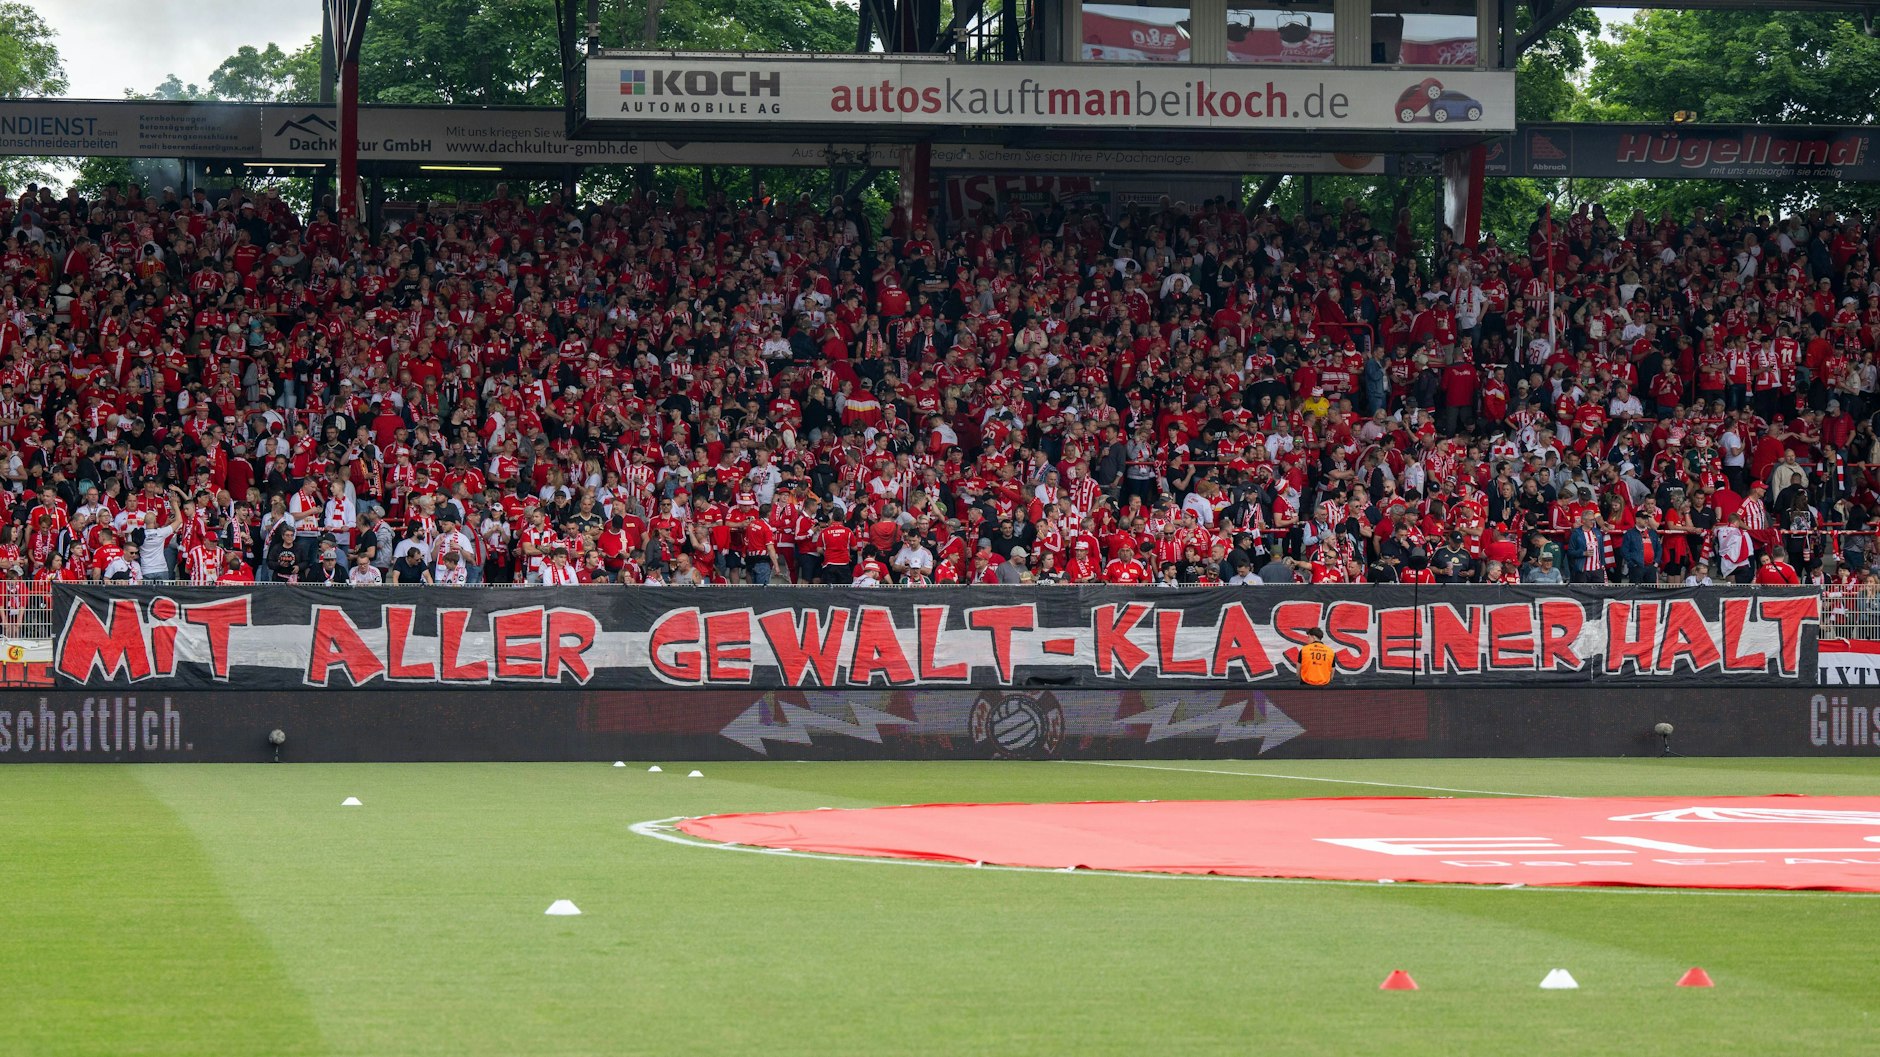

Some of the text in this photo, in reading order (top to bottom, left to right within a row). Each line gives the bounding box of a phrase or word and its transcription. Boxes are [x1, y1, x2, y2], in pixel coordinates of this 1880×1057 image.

[652, 70, 781, 97] KOCH
[831, 78, 1349, 119] autoskauftmanbeikoch.de
[620, 102, 782, 114] AUTOMOBILE AG
[2, 117, 97, 136] NDIENST
[446, 126, 465, 137] Mit
[468, 129, 487, 138] uns
[490, 126, 531, 141] kriegen
[534, 127, 550, 138] Sie
[290, 138, 432, 152] DachKtur GmbH
[446, 140, 638, 156] www.dachkultur-gmbh.de
[1616, 131, 1863, 168] Hügelland
[792, 148, 814, 158] Aus
[978, 150, 1022, 162] Sichern
[1024, 150, 1042, 162] Sie
[1045, 150, 1067, 162] sich
[1070, 151, 1092, 162] Ihre
[1532, 163, 1567, 171] Abbruch
[1710, 166, 1842, 179] mit uns entsorgen sie richtig
[303, 604, 602, 687] ALLER
[1311, 652, 1327, 661] 101
[1313, 836, 1880, 855] EL
